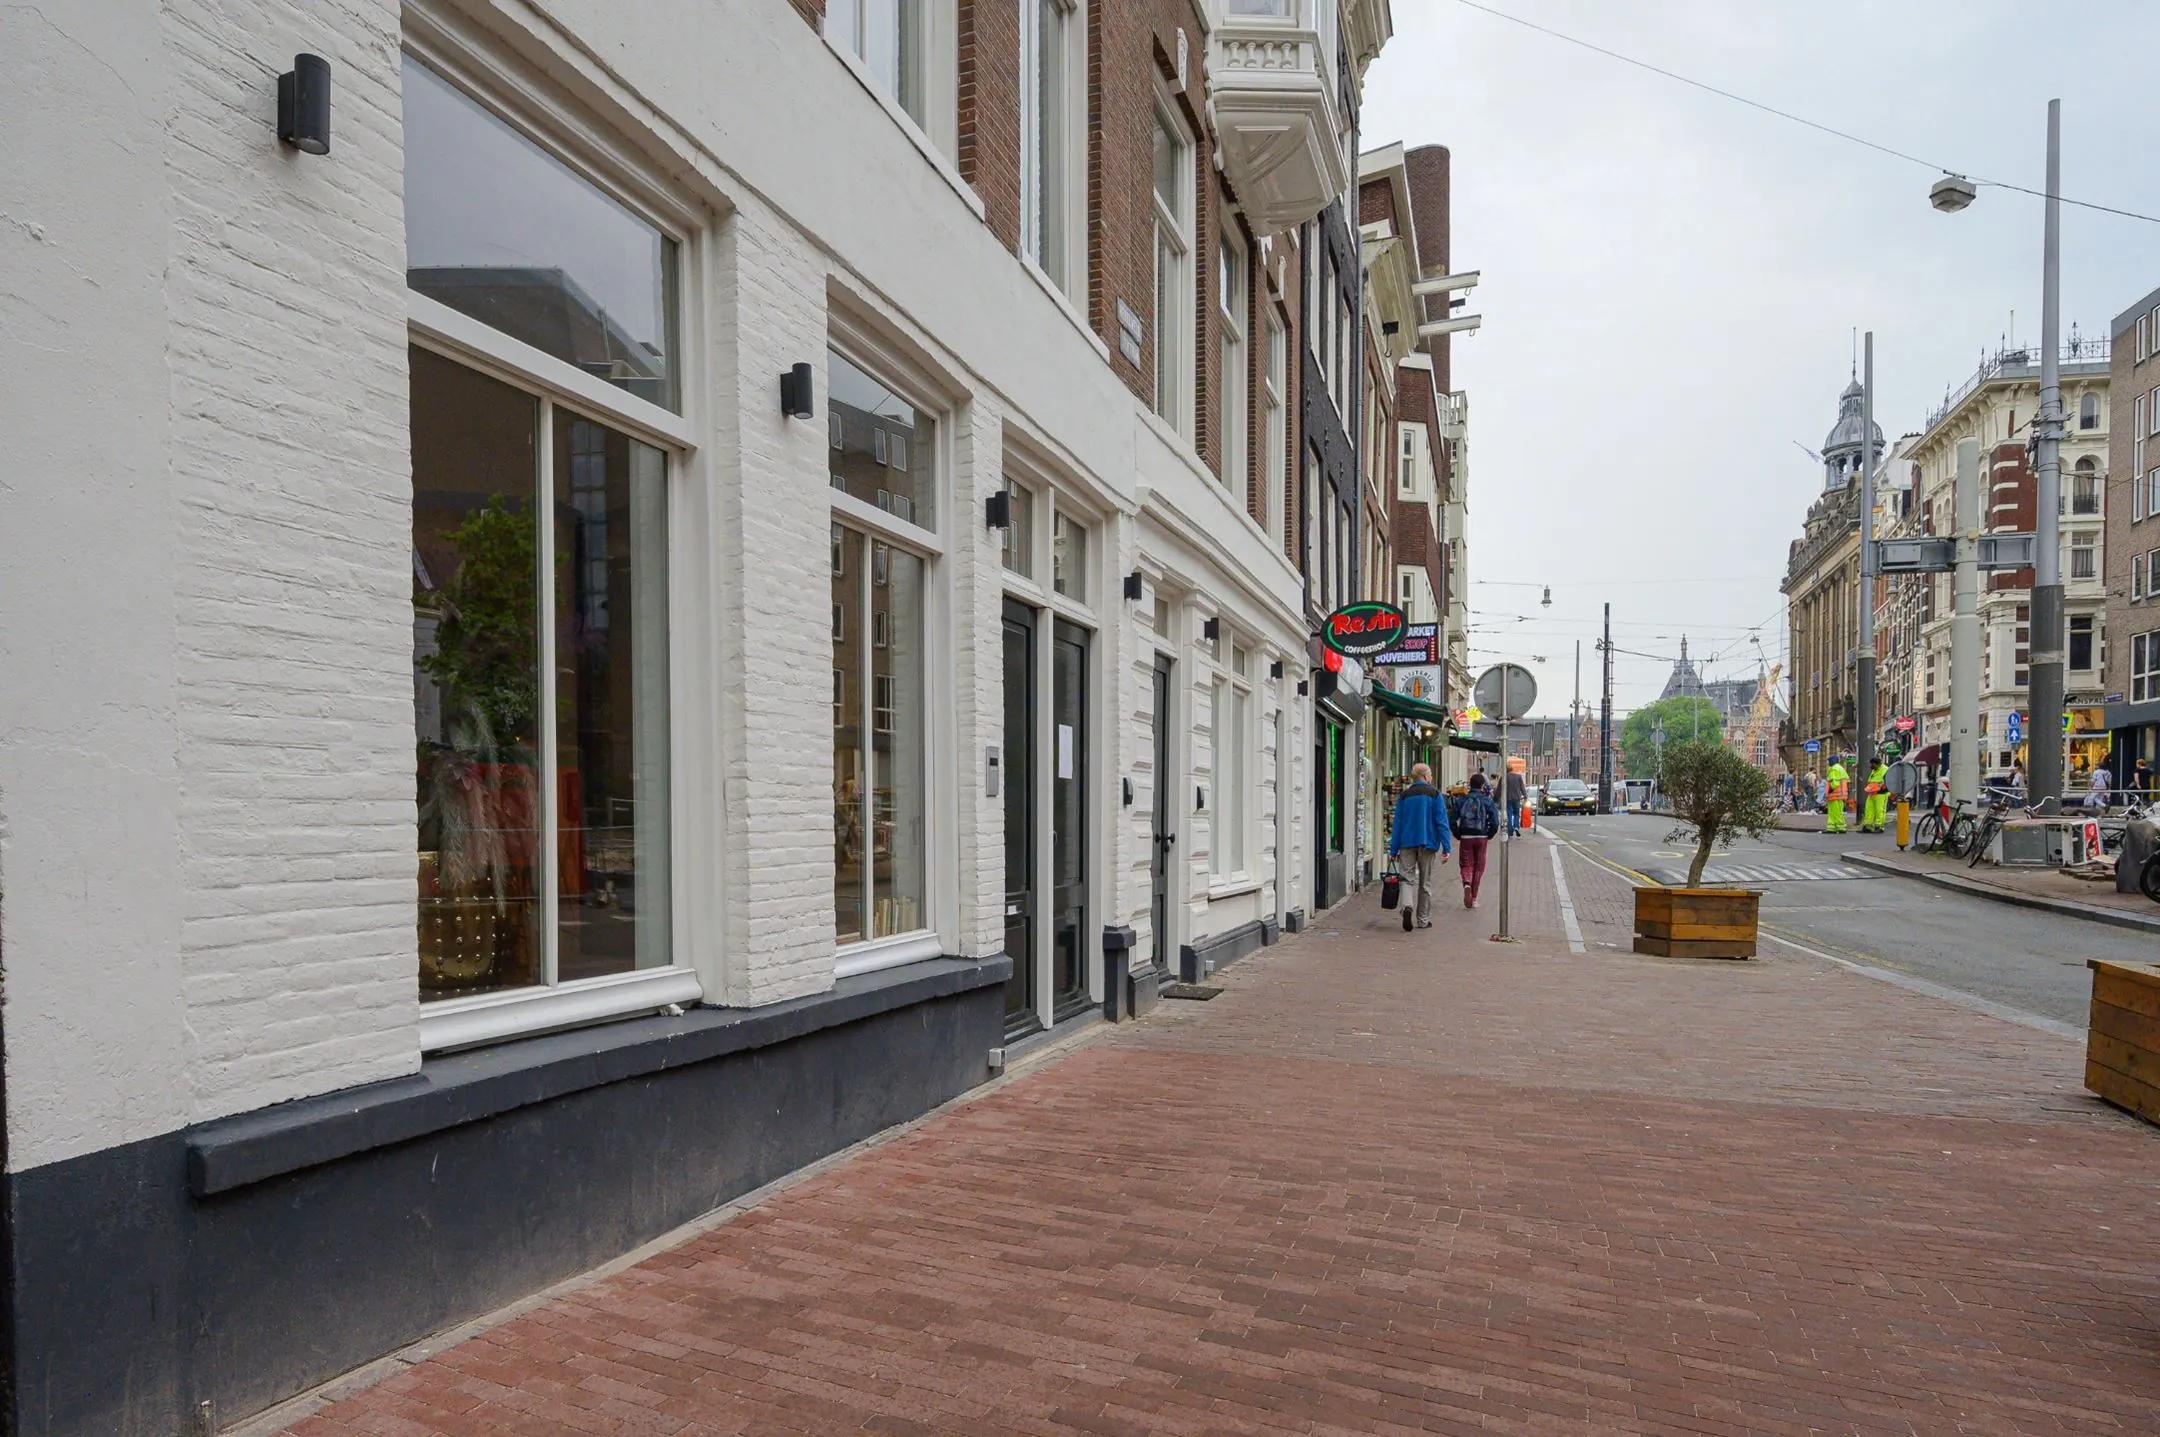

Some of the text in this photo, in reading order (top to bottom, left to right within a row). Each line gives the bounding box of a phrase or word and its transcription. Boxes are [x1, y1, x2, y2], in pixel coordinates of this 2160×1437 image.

[1331, 608, 1402, 635] Resin
[1407, 626, 1436, 637] ARKET
[1344, 641, 1387, 654] COFFEESHOP
[1404, 639, 1428, 649] SHOP
[1914, 649, 1924, 699] HOTEL
